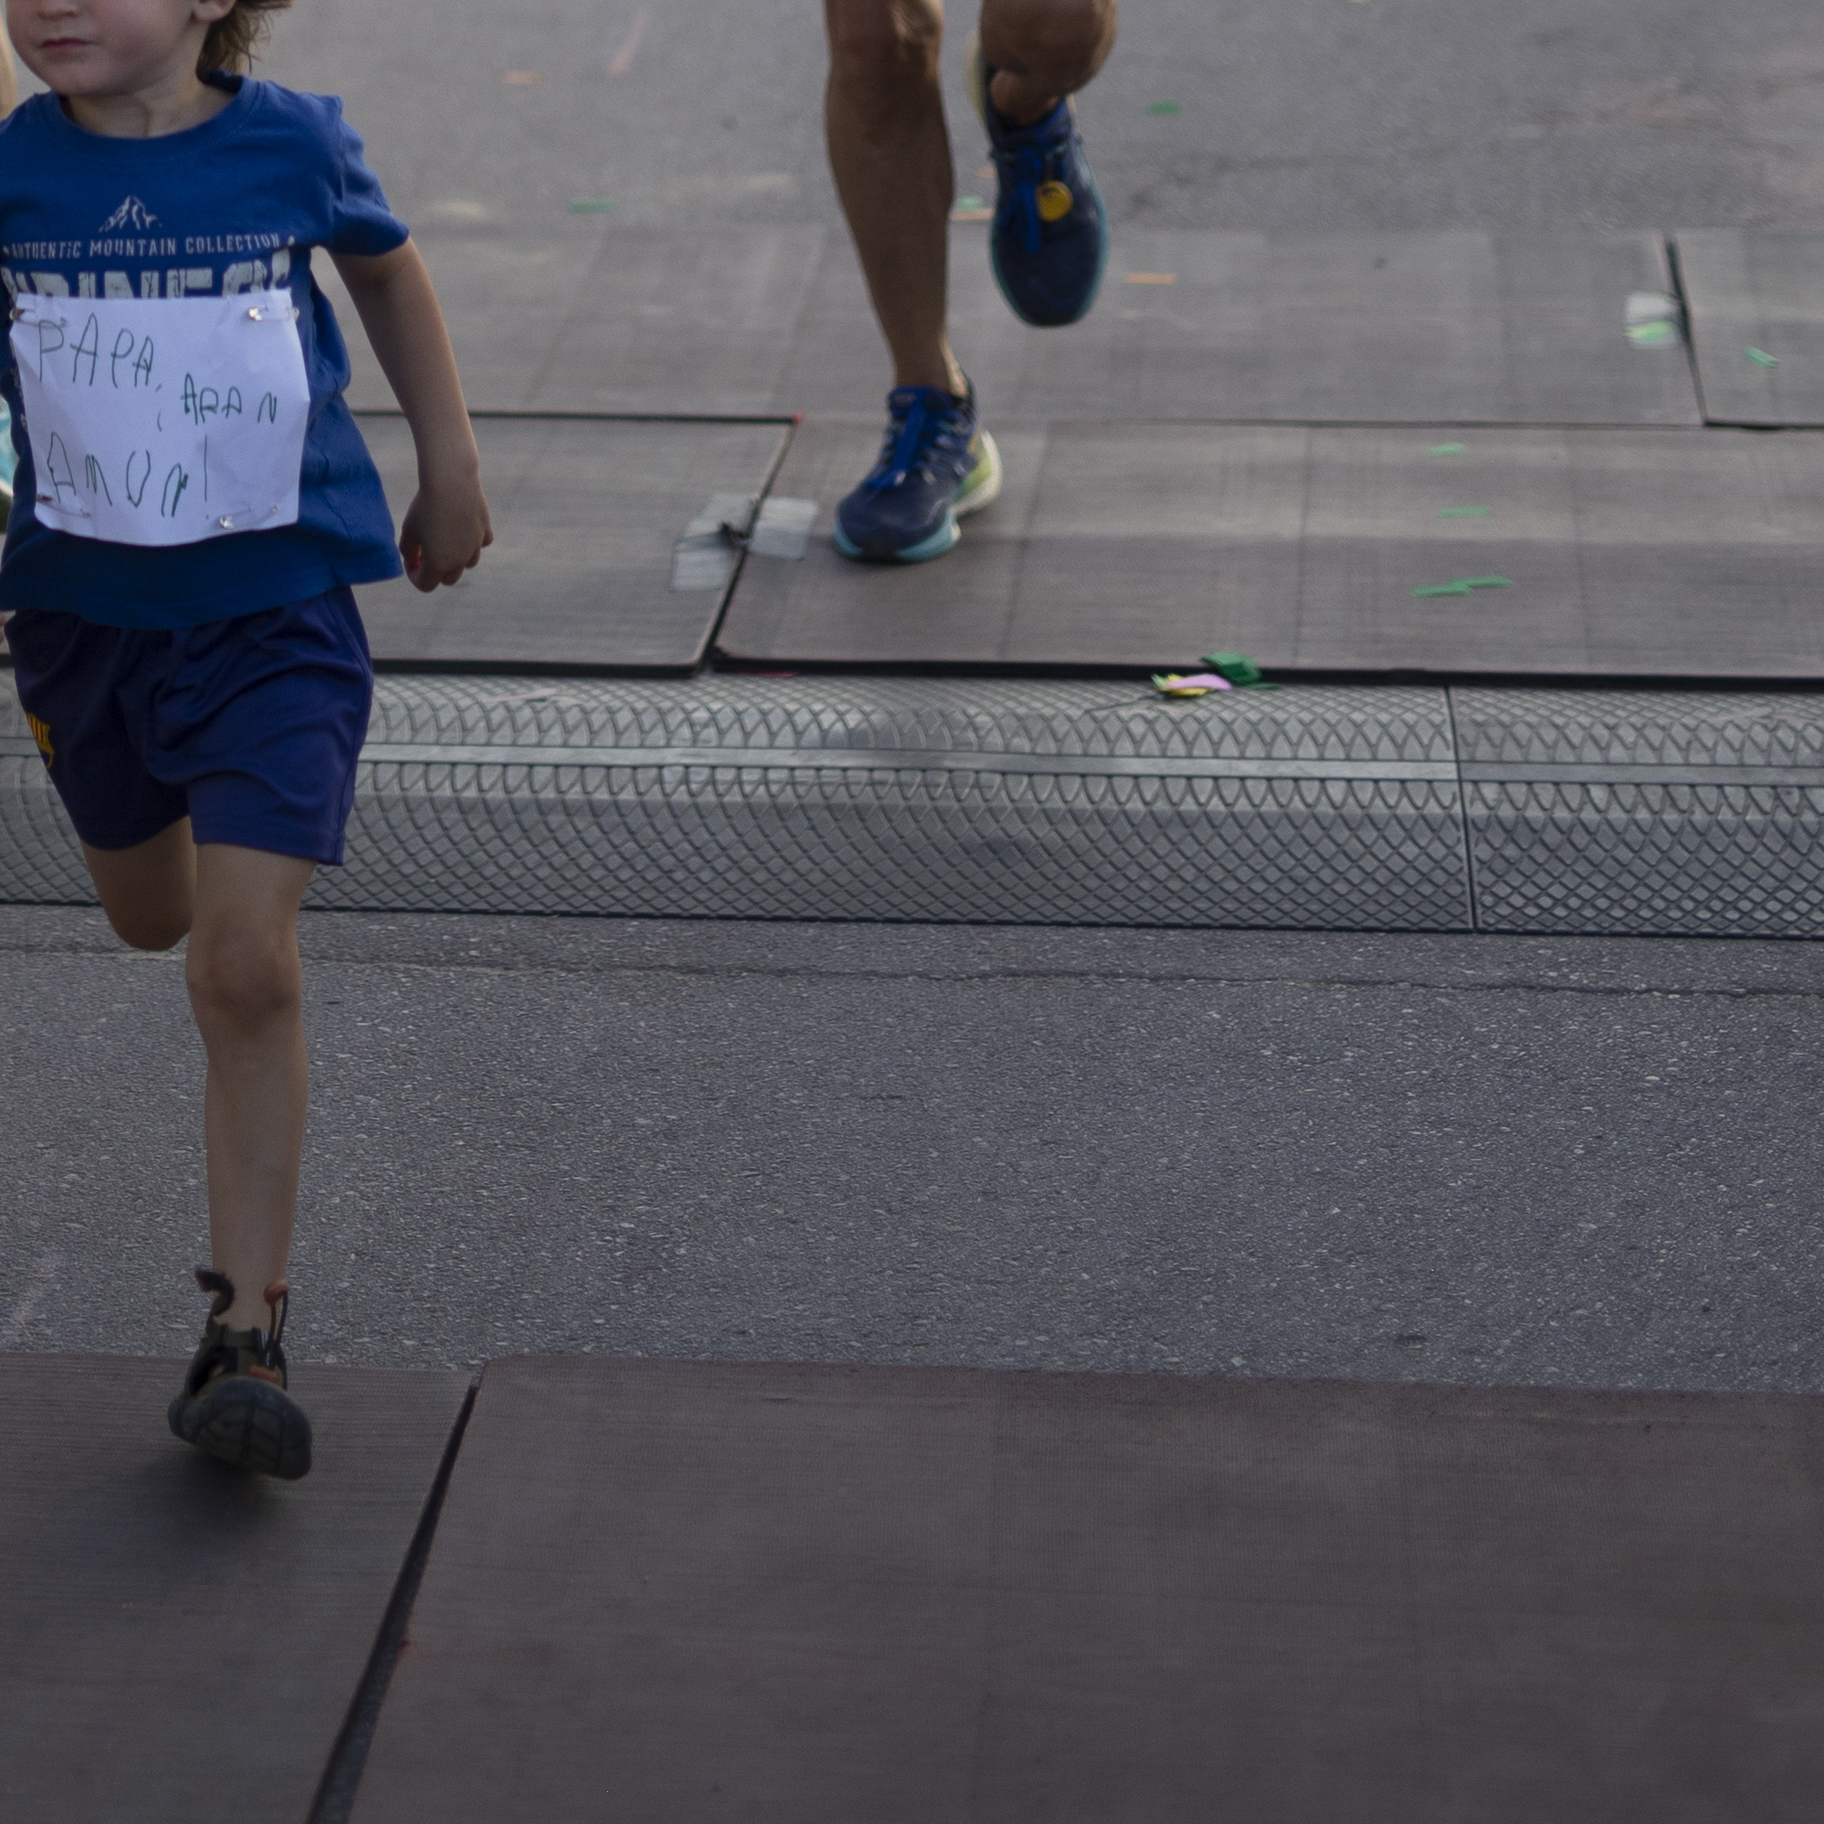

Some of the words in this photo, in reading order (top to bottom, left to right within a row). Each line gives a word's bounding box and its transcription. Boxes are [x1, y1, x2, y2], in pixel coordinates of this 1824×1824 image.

[11, 240, 82, 260] AUTHENTIC
[89, 238, 176, 257] MOUNTAIN
[185, 233, 281, 255] COLLECTION
